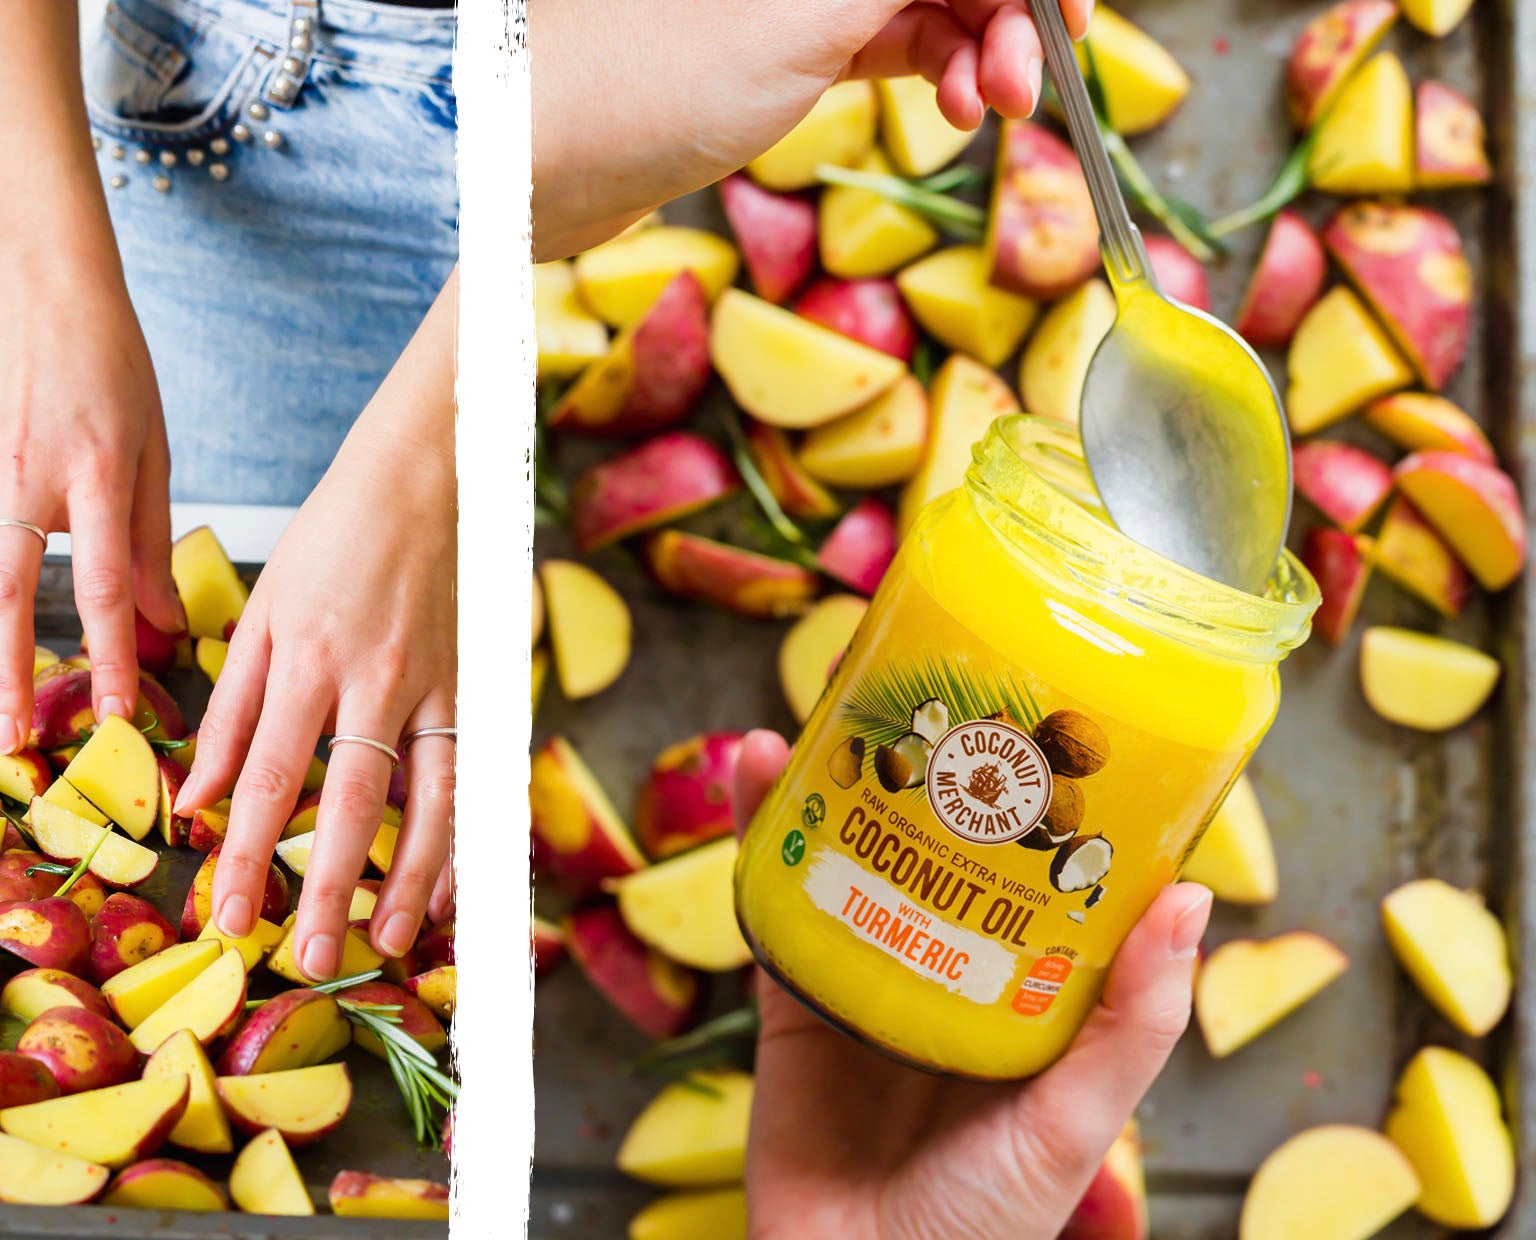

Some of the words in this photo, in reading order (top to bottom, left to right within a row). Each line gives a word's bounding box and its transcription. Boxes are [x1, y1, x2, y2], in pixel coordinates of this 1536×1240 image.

[960, 730, 1041, 788] COCONUT
[936, 771, 1022, 835] MERCHANT
[839, 806, 986, 921] COCONUT
[981, 897, 1035, 947] OIL
[861, 787, 888, 816] RAW
[888, 811, 949, 858] ORGANIC
[950, 852, 996, 885] EXTRA
[1001, 877, 1052, 907] VIRGIN
[841, 885, 970, 981] TURMERIC
[897, 902, 933, 929] WITH
